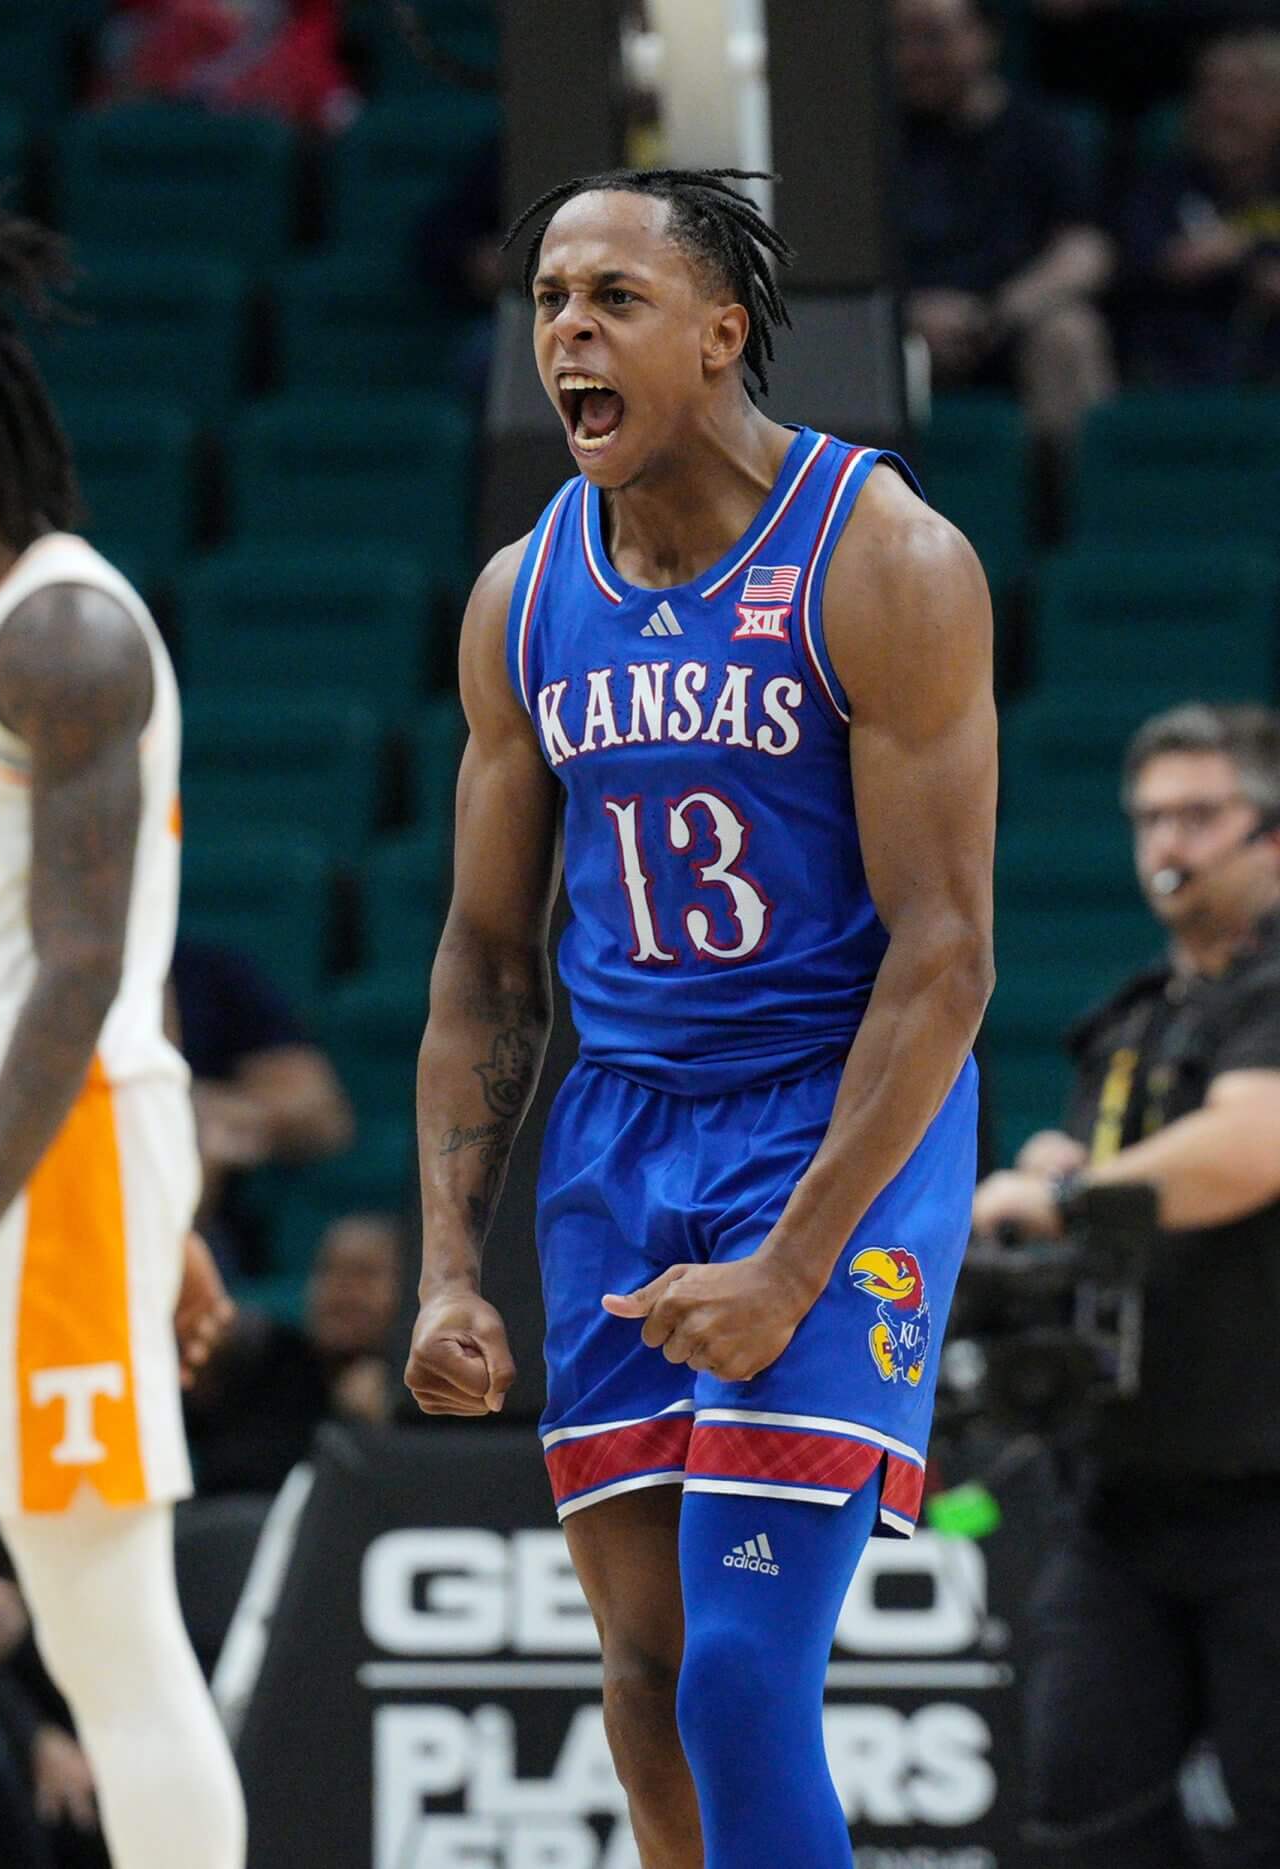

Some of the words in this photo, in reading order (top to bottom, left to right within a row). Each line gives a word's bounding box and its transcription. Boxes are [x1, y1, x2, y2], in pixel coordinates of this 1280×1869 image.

[735, 607, 789, 638] XII
[537, 661, 803, 766] KANSAS
[604, 789, 770, 964] 13
[899, 1321, 920, 1350] KU
[30, 1360, 126, 1466] T
[360, 1527, 987, 1656] GEO
[722, 1553, 781, 1577] adidas
[372, 1702, 997, 1827] PLARS
